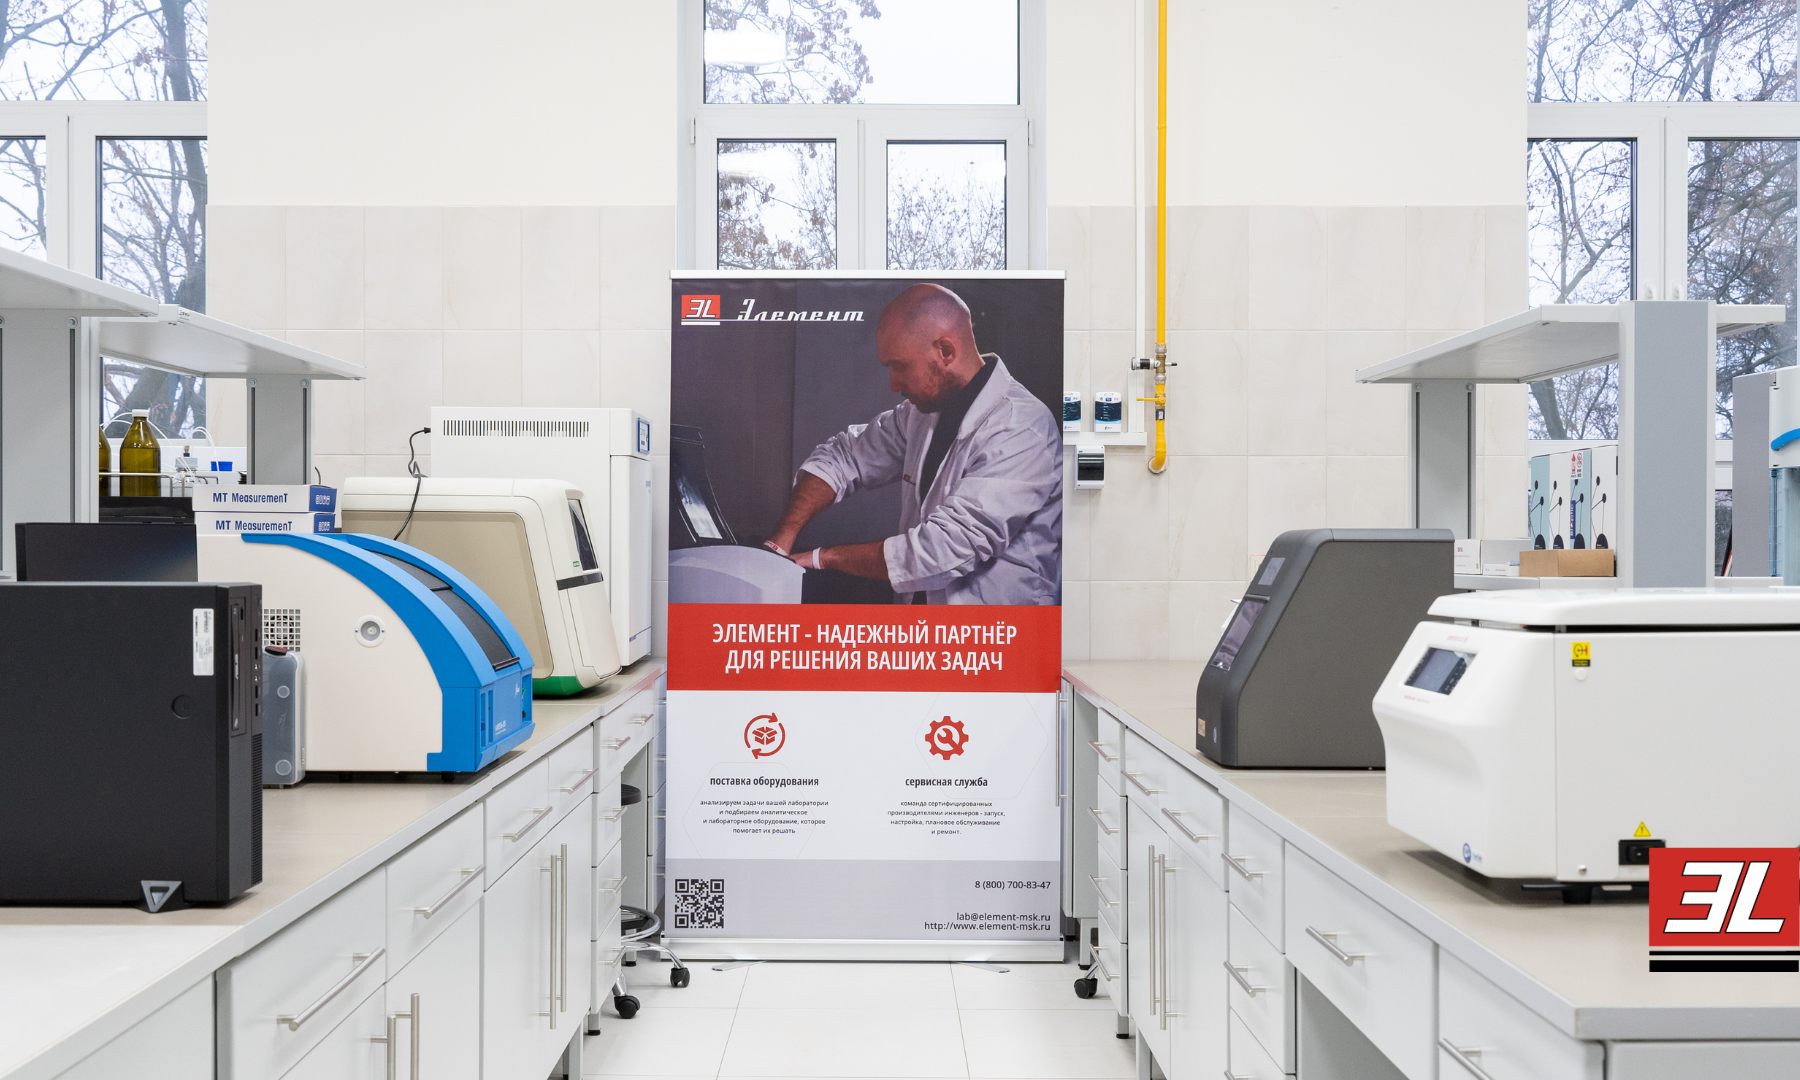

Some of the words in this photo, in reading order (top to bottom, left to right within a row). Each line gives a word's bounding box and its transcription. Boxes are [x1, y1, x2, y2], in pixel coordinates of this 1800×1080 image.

[737, 298, 864, 321] Элемент
[212, 492, 228, 503] MT
[215, 520, 231, 531] MT
[712, 623, 801, 643] ЭЛЕМЕНТ
[817, 620, 930, 648] НАДЕЖНЫЙ
[934, 621, 1017, 645] ПАРТНЁР
[725, 650, 764, 674] ДЛЯ
[770, 650, 861, 670] РЕШЕНИЯ
[867, 651, 937, 671] ВАШИХ
[940, 651, 1003, 675] ЗАДАЧ
[710, 777, 751, 786] поставка
[753, 776, 819, 788] оборудования
[905, 778, 952, 788] сервисная
[954, 777, 988, 789] служба
[724, 808, 759, 816] подбираем
[708, 817, 752, 825] лабораторное
[955, 819, 1001, 827] обслуживание
[974, 880, 981, 889] 8
[982, 880, 1005, 891] (800)
[1007, 880, 1051, 890] 700-83-47
[956, 911, 1051, 921] lab@element-msk.ru
[924, 920, 1051, 932] http://www.element-msk.ru
